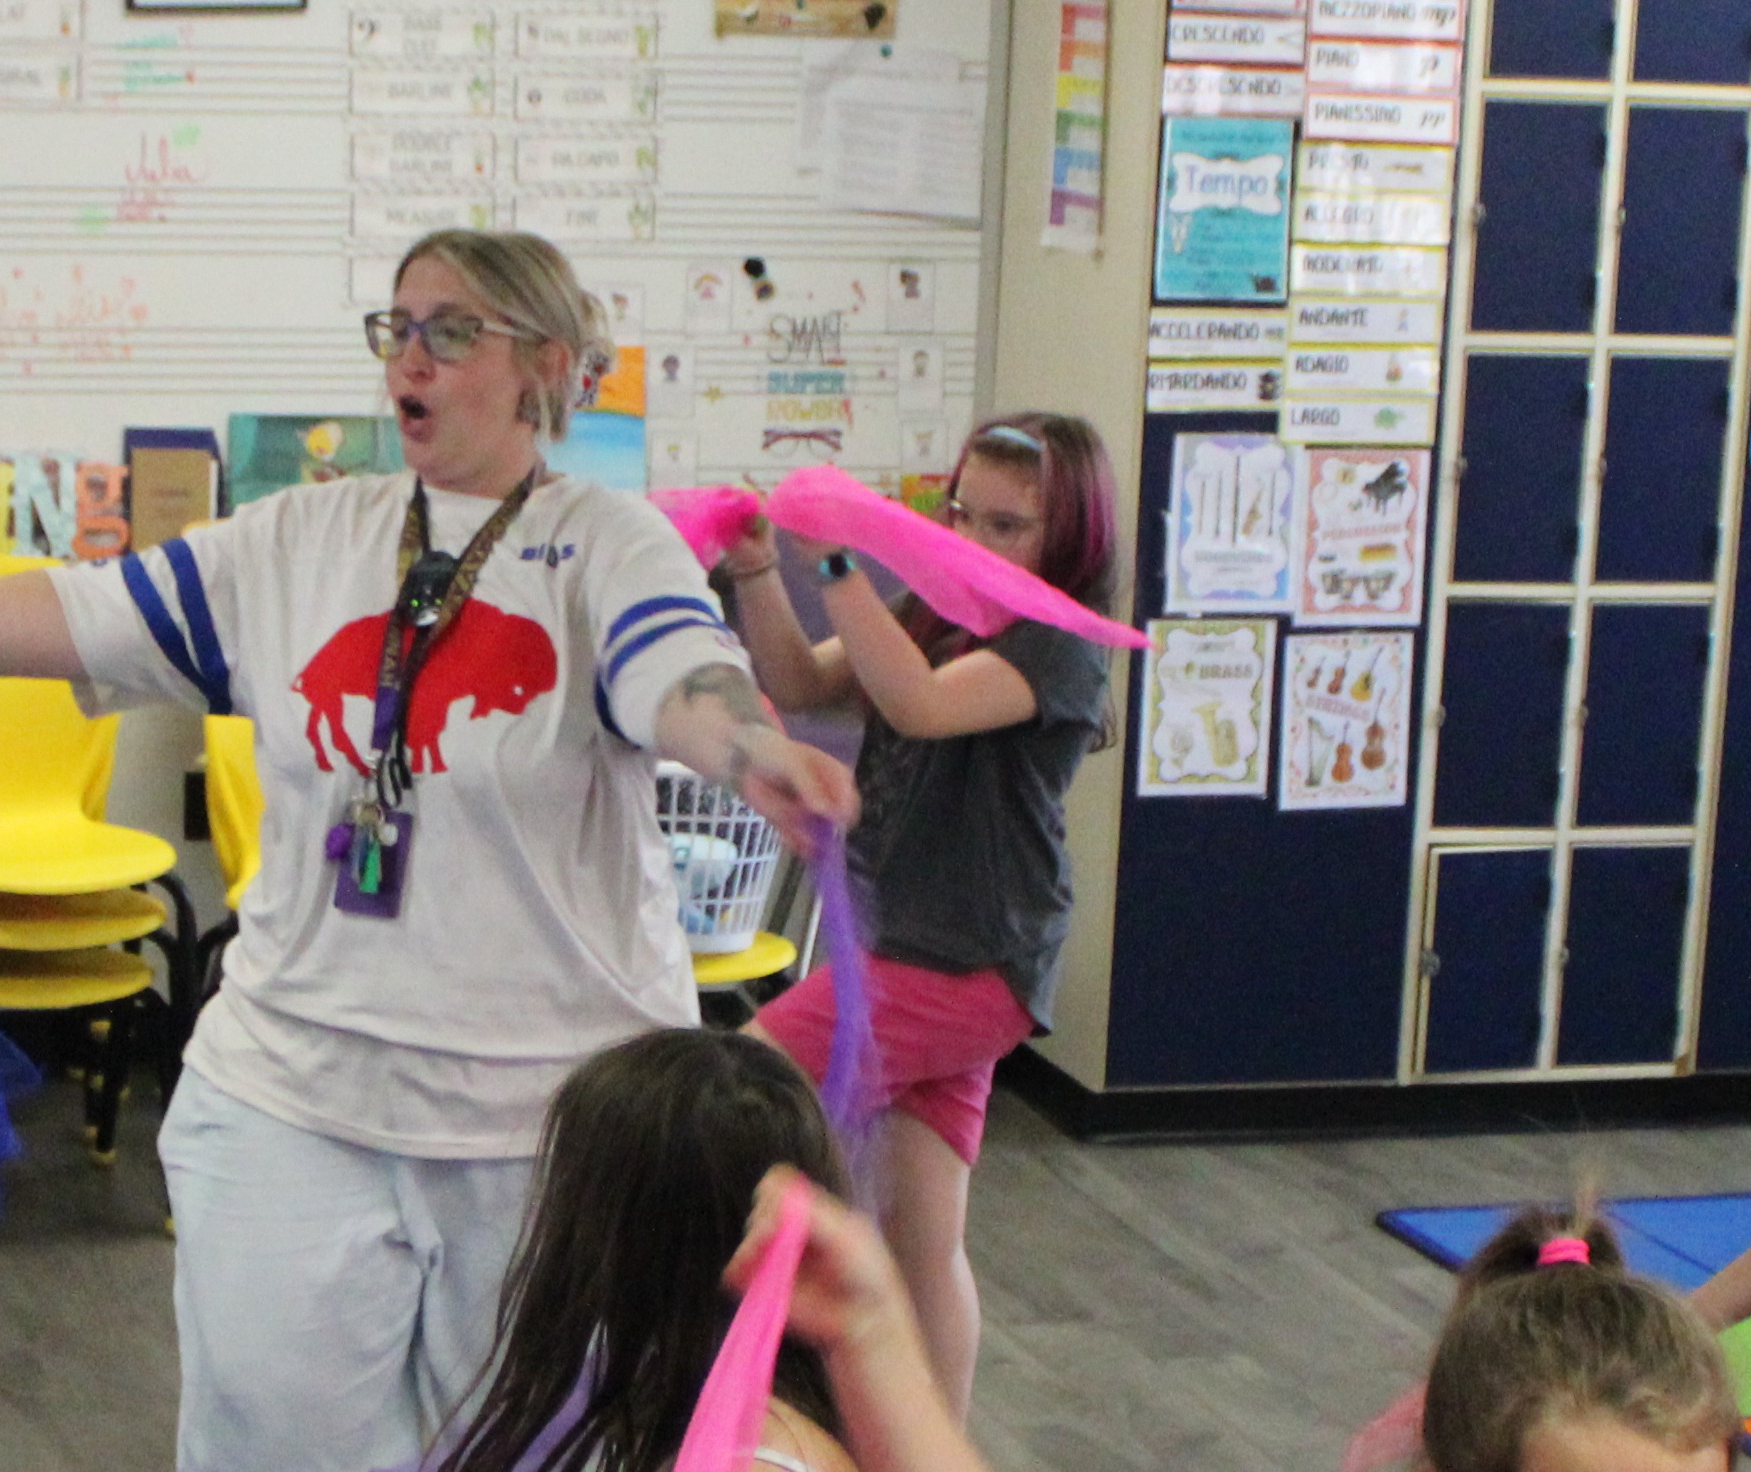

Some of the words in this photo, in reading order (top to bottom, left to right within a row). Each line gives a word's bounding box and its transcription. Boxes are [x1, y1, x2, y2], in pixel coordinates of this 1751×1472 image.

[1170, 23, 1265, 45] CRESCENDO
[1185, 164, 1268, 198] Tempo
[1298, 307, 1369, 328] ANDANTE
[1148, 320, 1259, 342] ACCELERANDO
[1294, 355, 1349, 375] ADAGIO
[1291, 406, 1340, 427] LARGO
[1199, 662, 1253, 681] BRASS
